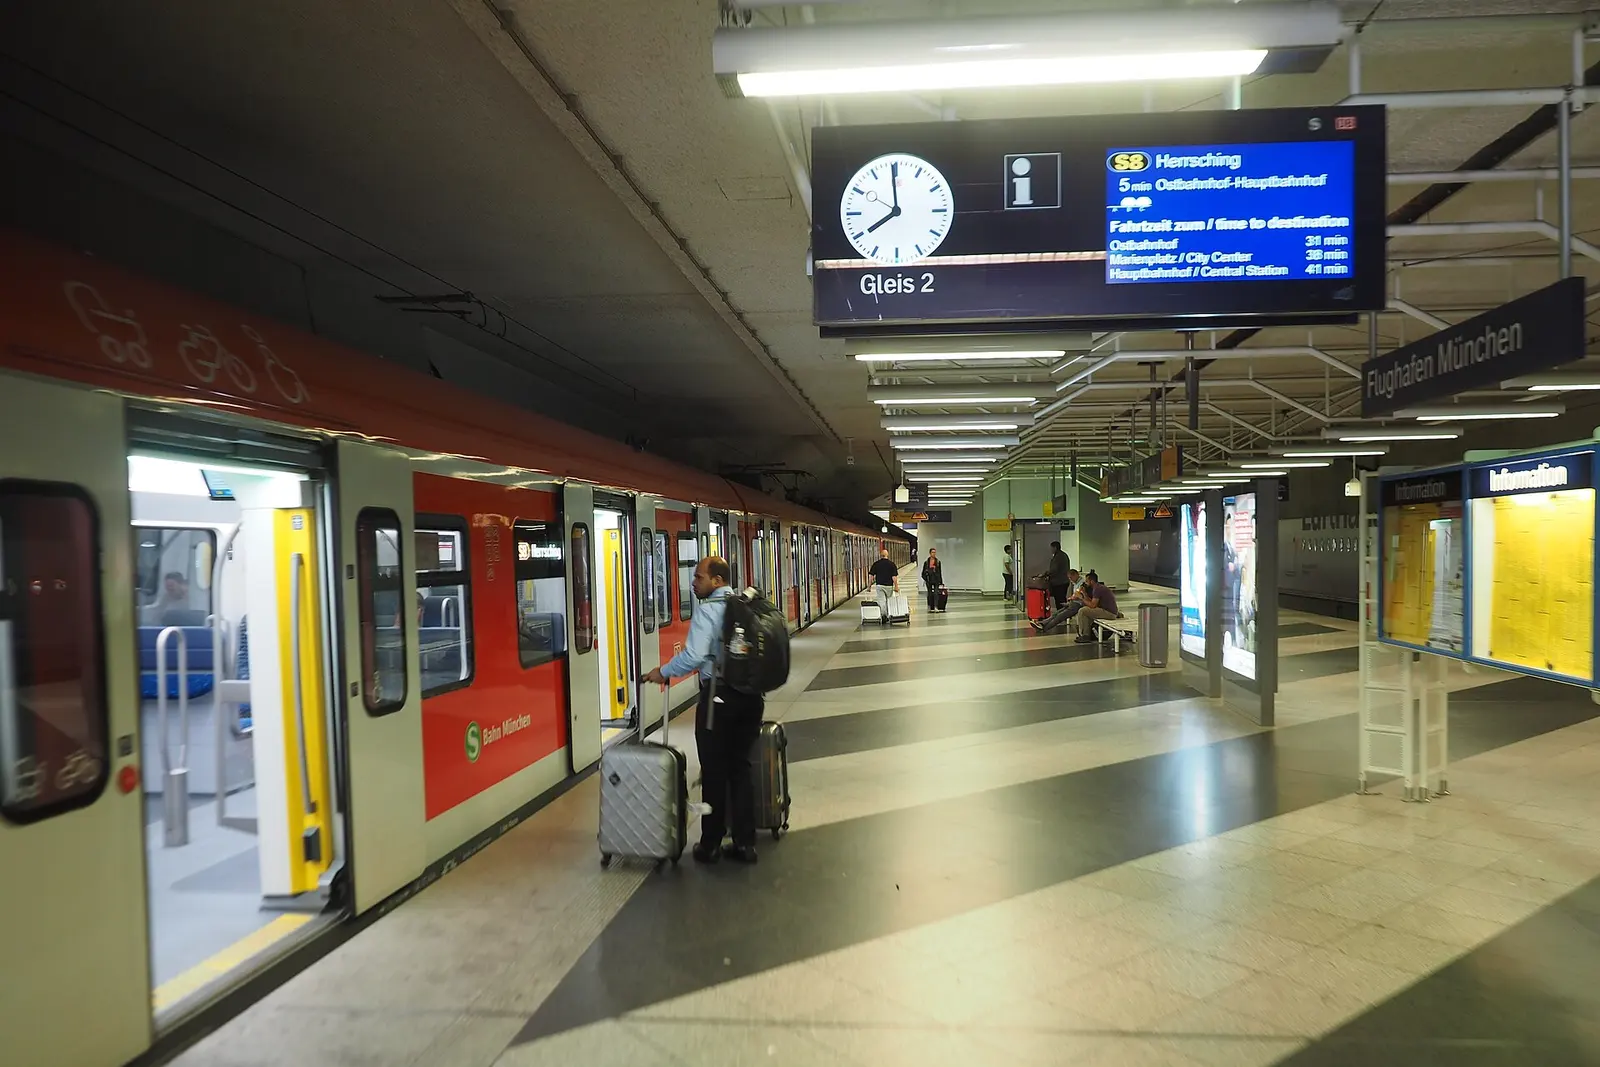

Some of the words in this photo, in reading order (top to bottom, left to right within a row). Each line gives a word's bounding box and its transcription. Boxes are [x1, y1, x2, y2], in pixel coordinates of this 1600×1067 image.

[1308, 117, 1322, 131] S
[1114, 153, 1144, 170] S8
[1155, 152, 1241, 170] Herrsching
[1119, 178, 1131, 192] 5
[1131, 181, 1152, 192] min
[1155, 174, 1328, 191] Ostbahnhof-Hauptbahnhof
[1109, 219, 1173, 233] Fahrtzeit
[1174, 220, 1206, 231] zum
[1206, 218, 1215, 231] /
[1215, 217, 1248, 231] time
[1249, 217, 1267, 230] to
[1267, 215, 1350, 229] destination
[1109, 238, 1179, 251] Ostbahnhof
[1305, 235, 1322, 247] 31
[1323, 234, 1349, 246] min
[1109, 253, 1178, 266] Marienplatz
[1178, 252, 1186, 264] /
[1186, 252, 1211, 265] City
[1211, 251, 1254, 263] Center
[1305, 249, 1324, 261] 38
[1323, 248, 1349, 260] min
[1109, 266, 1194, 281] Hauptbahnhof
[1193, 266, 1200, 278] /
[1200, 265, 1245, 278] Central
[1245, 264, 1289, 277] Station
[1305, 263, 1322, 275] 41
[1323, 263, 1348, 275] min
[860, 272, 915, 295] Gleis
[920, 272, 935, 293] 2
[1366, 353, 1434, 399] Flughafen
[1437, 322, 1523, 376] München
[1489, 462, 1568, 492] Information
[1395, 477, 1447, 501] Information
[531, 543, 562, 560] Herrsching
[466, 723, 480, 761] S
[483, 725, 502, 746] Bahn
[502, 713, 531, 739] München
